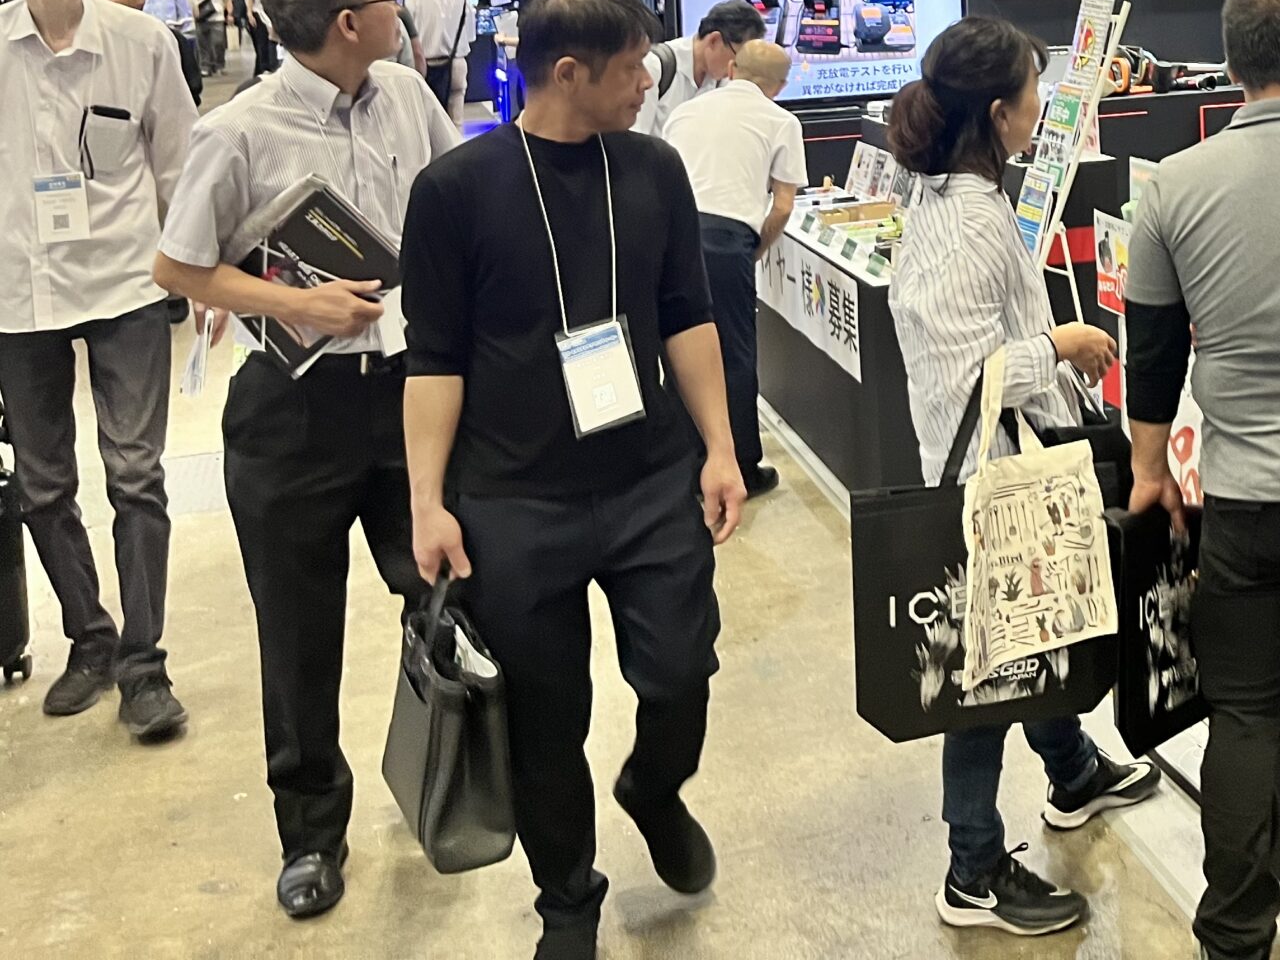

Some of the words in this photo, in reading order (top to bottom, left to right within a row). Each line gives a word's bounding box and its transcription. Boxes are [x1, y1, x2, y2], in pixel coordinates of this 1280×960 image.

[816, 64, 913, 80] 充放電テストを行い
